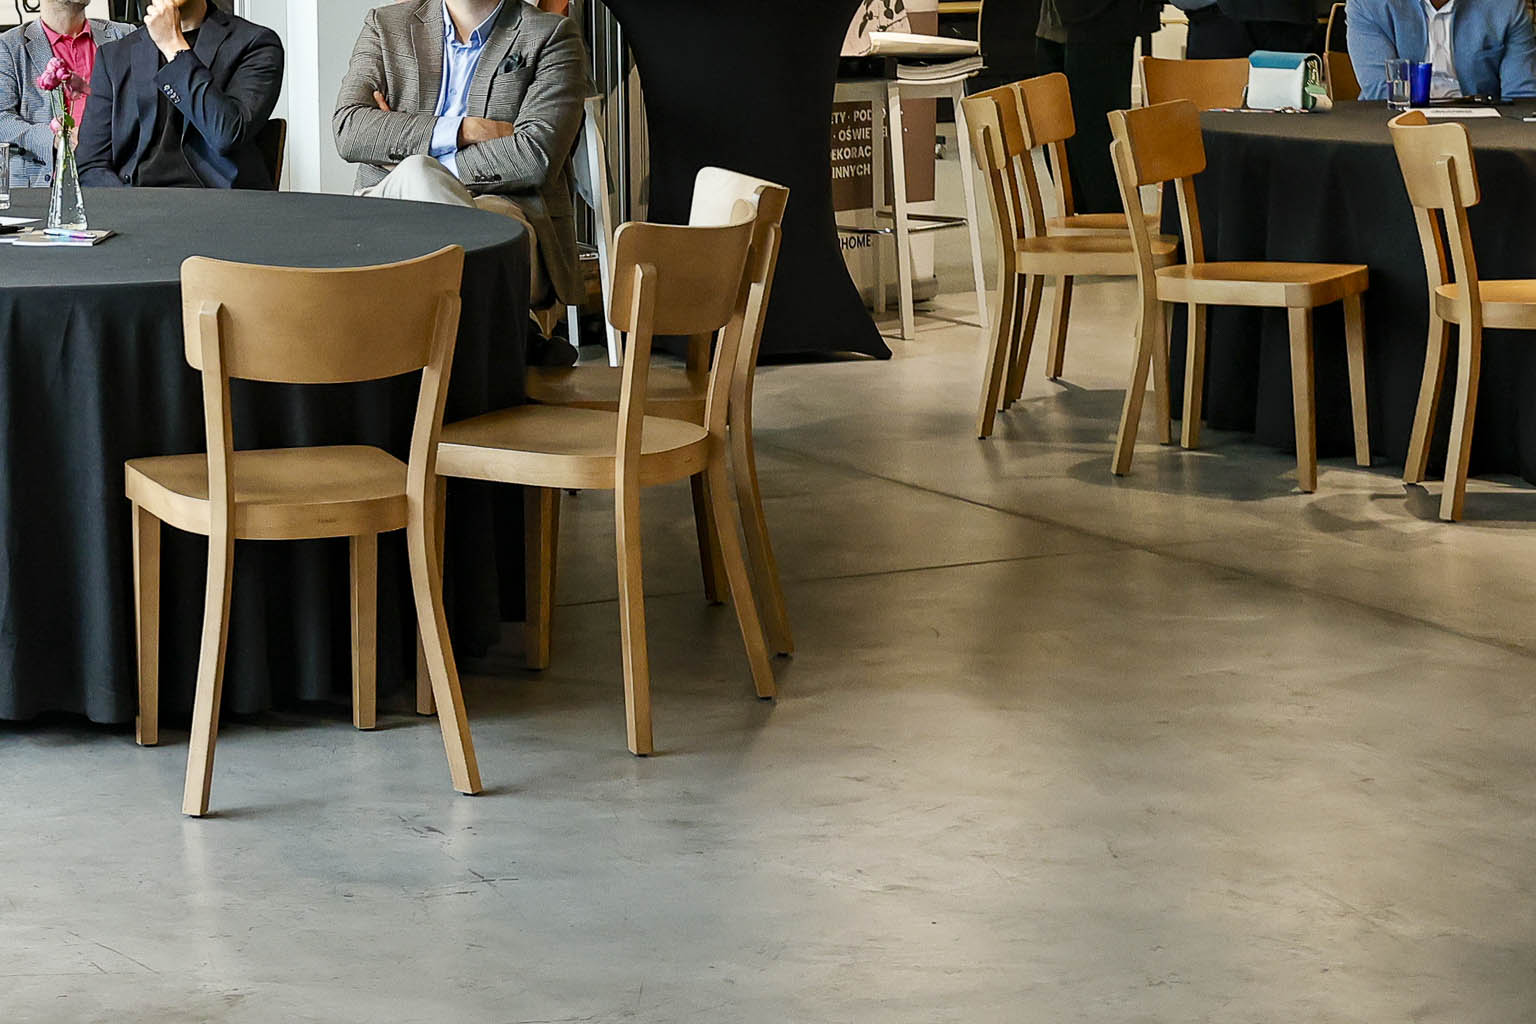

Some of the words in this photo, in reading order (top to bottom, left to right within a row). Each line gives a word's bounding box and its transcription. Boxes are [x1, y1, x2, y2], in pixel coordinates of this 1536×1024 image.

[831, 112, 846, 125] TY
[831, 144, 872, 161] EKORAC
[832, 163, 871, 179] INNYCH
[838, 234, 872, 250] HOME
